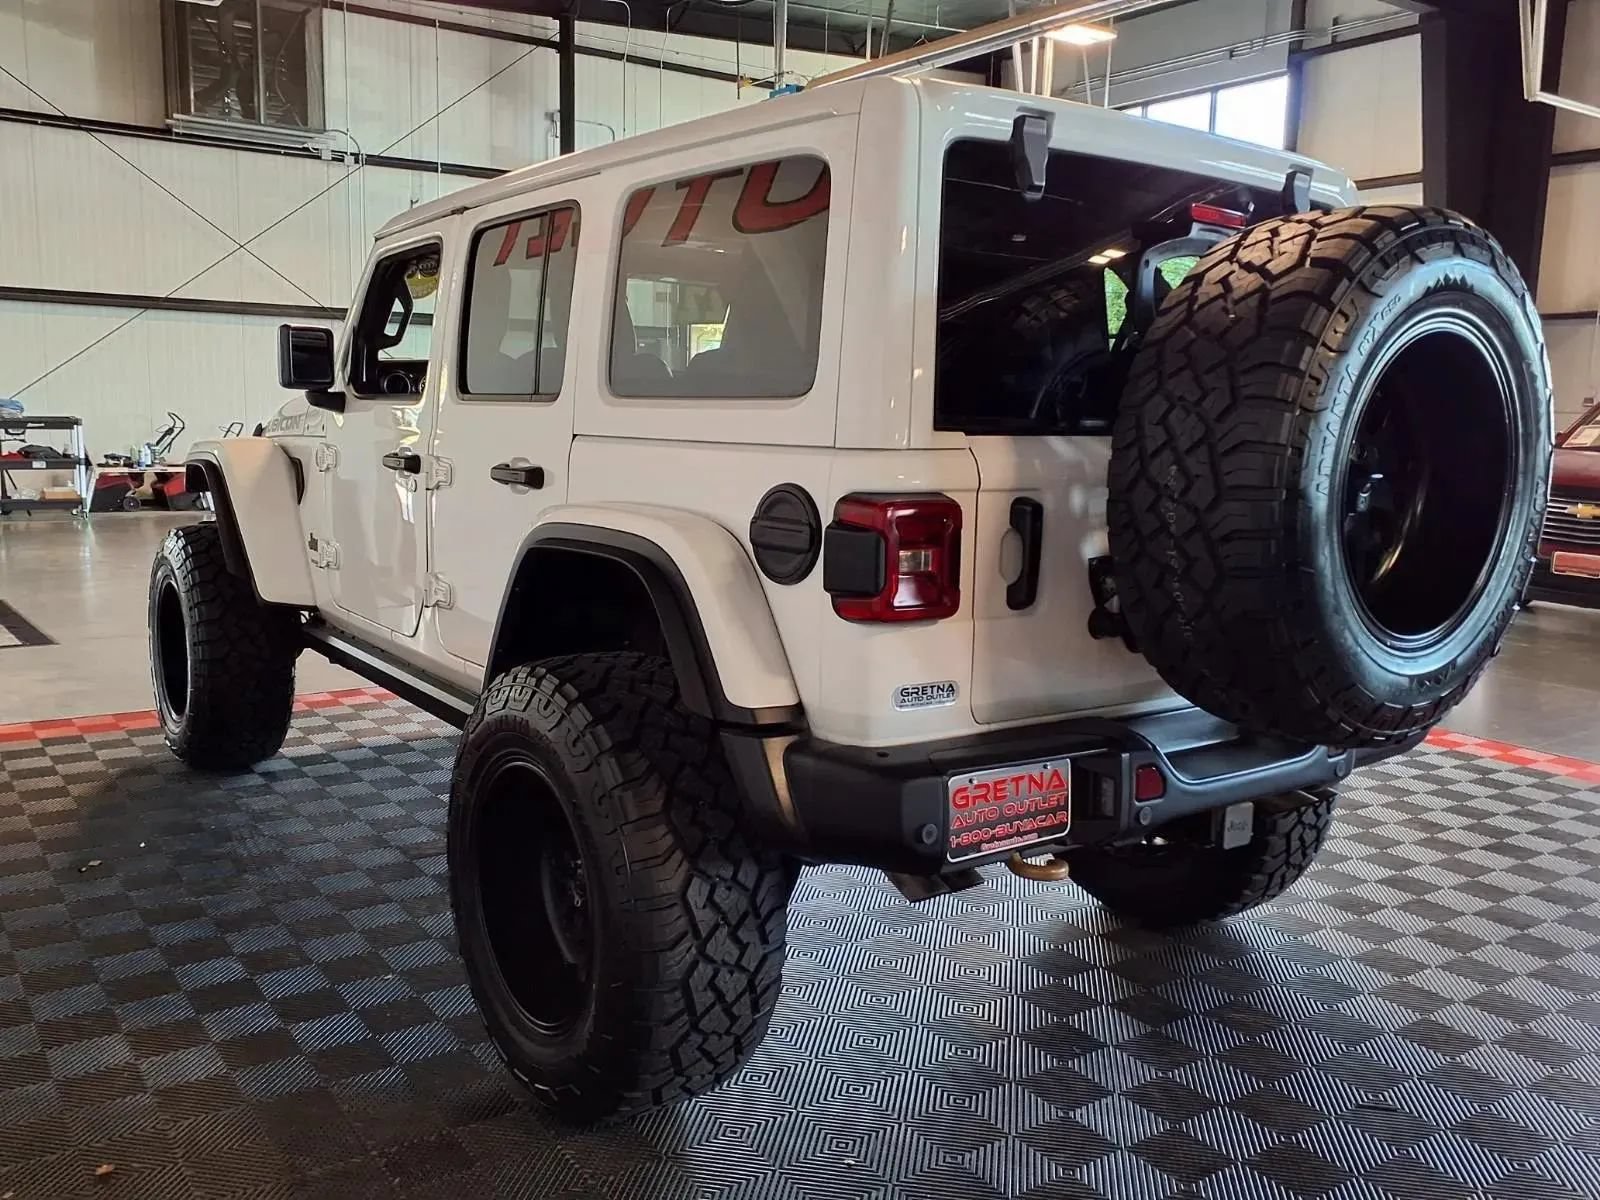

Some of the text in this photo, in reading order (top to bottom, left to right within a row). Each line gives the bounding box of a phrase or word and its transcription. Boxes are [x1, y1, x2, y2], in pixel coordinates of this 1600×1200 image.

[900, 683, 955, 697] GRETNA
[900, 692, 955, 703] AUTO OUTLET
[952, 769, 1067, 810] GRETNA
[951, 792, 1068, 829] AUTO OUTLET
[950, 811, 1068, 848] 1-800-BUYACAR
